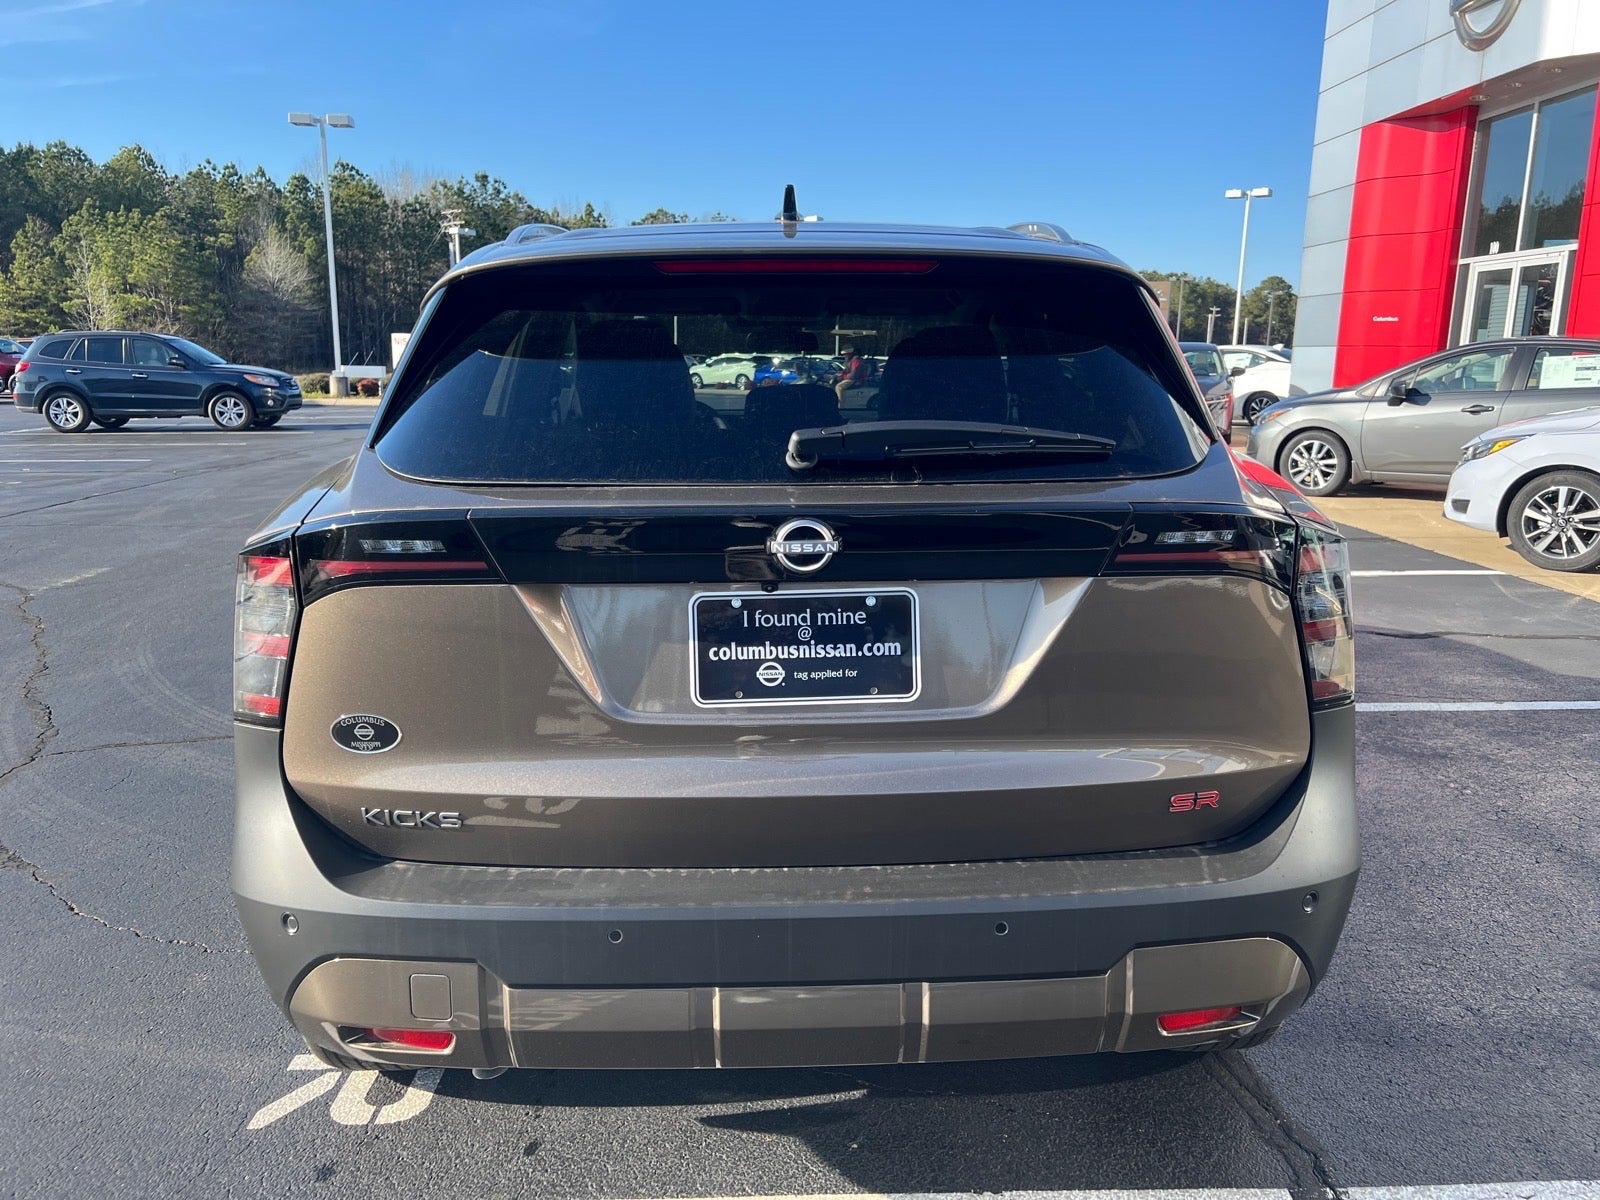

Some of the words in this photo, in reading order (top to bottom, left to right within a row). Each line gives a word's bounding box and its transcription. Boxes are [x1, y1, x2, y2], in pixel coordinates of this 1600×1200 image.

[774, 543, 837, 552] NISSAN
[743, 611, 748, 627] I
[755, 609, 810, 627] found
[817, 608, 867, 625] mine
[798, 627, 812, 641] @
[709, 640, 901, 660] columbusnissan.com
[794, 671, 808, 680] tag
[810, 669, 842, 680] applied
[845, 668, 858, 677] for
[340, 716, 385, 726] COLUMBUS
[1169, 790, 1219, 812] SR
[361, 807, 462, 828] KICKS
